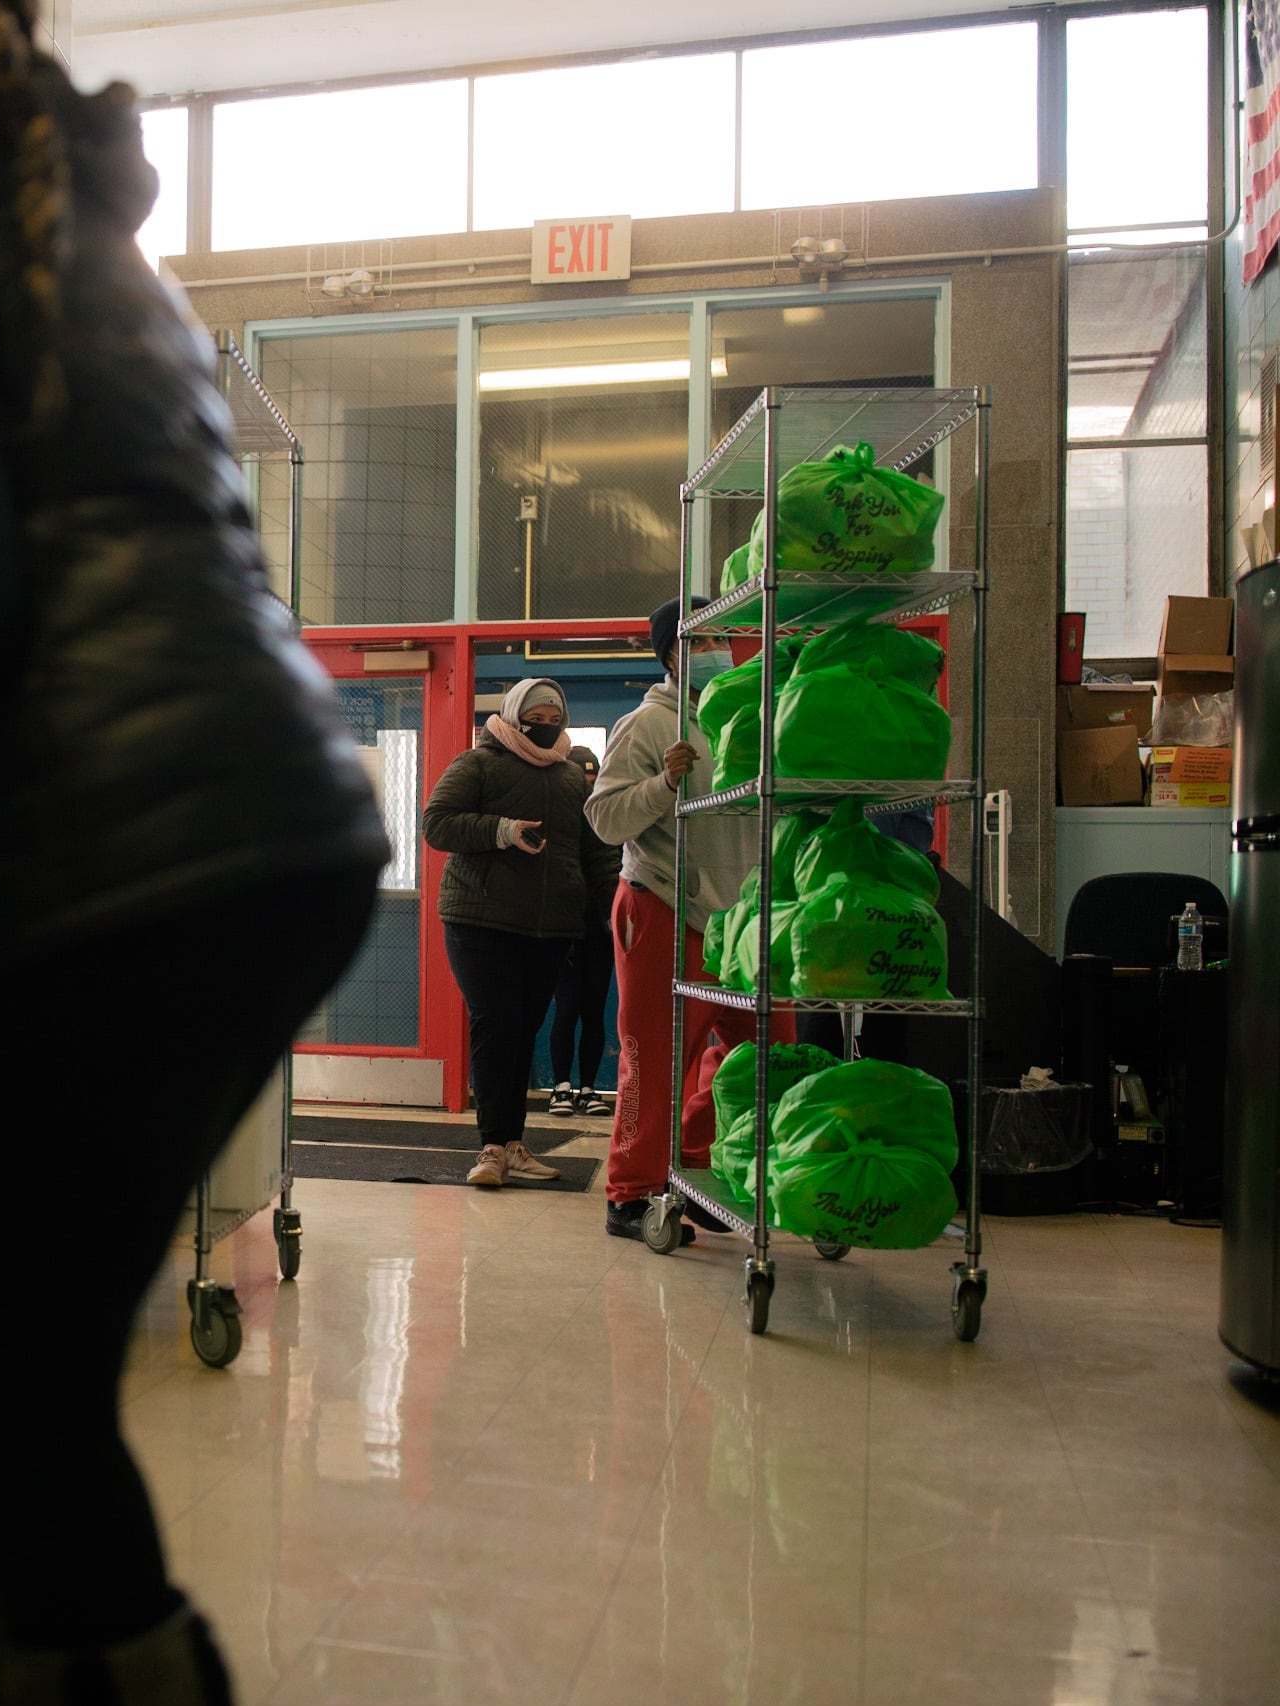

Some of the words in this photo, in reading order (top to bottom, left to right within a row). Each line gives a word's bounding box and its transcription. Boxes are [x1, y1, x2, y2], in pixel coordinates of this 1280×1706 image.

[548, 223, 614, 275] EXIT
[846, 514, 874, 536] For
[864, 496, 901, 518] You
[811, 531, 896, 572] Shopping
[896, 927, 925, 950] For
[866, 950, 942, 988] Shopping
[812, 1192, 866, 1222] Thank
[864, 1196, 900, 1228] You
